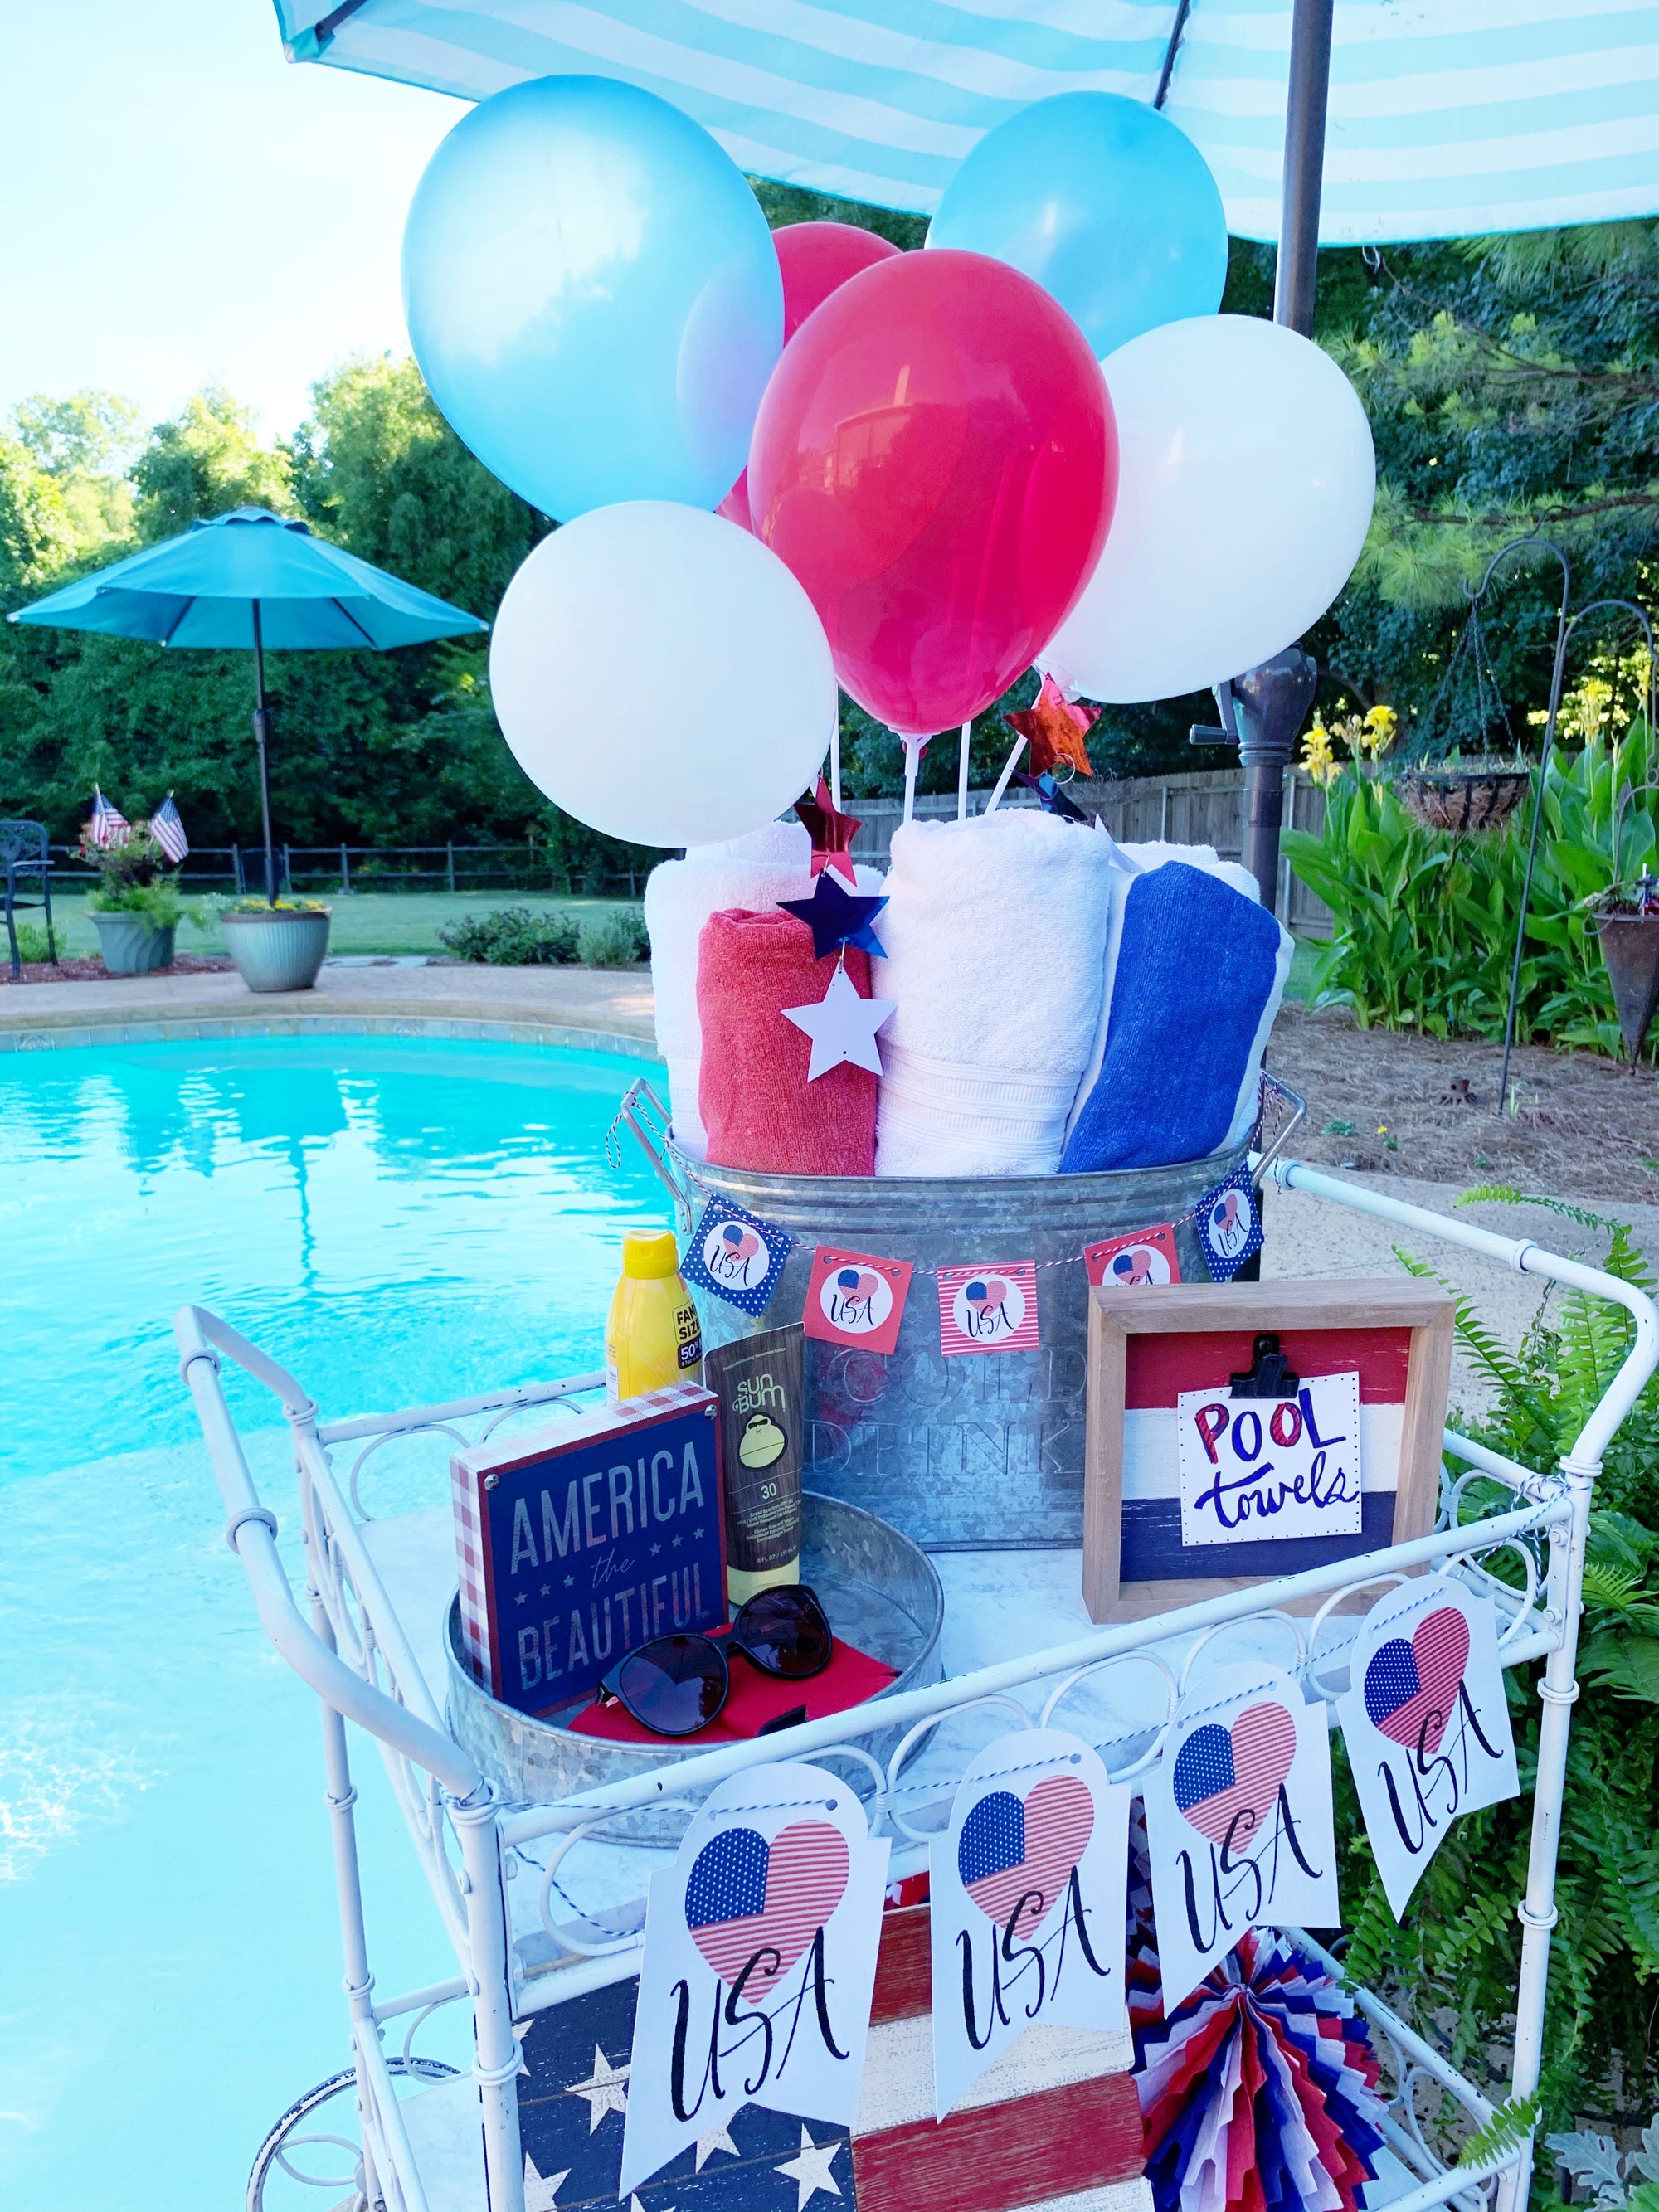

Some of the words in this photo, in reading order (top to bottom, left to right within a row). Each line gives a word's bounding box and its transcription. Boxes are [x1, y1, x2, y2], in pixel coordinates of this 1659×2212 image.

[709, 1244, 751, 1286] USA
[1218, 1212, 1248, 1256] USA
[830, 1293, 876, 1326] USA
[965, 1300, 1014, 1337] USA
[828, 1348, 1088, 1407] COLD
[1194, 1388, 1346, 1464] POOL
[510, 1441, 705, 1575] AMERICA
[760, 1482, 777, 1500] 30
[1194, 1450, 1360, 1528] towels
[591, 1547, 635, 1589] the
[518, 1563, 711, 1691] BEAUTIFUL
[1377, 1678, 1504, 1854] USA
[1175, 1782, 1323, 1954] USA
[956, 1865, 1111, 2050] USA
[670, 1926, 850, 2122] USA
